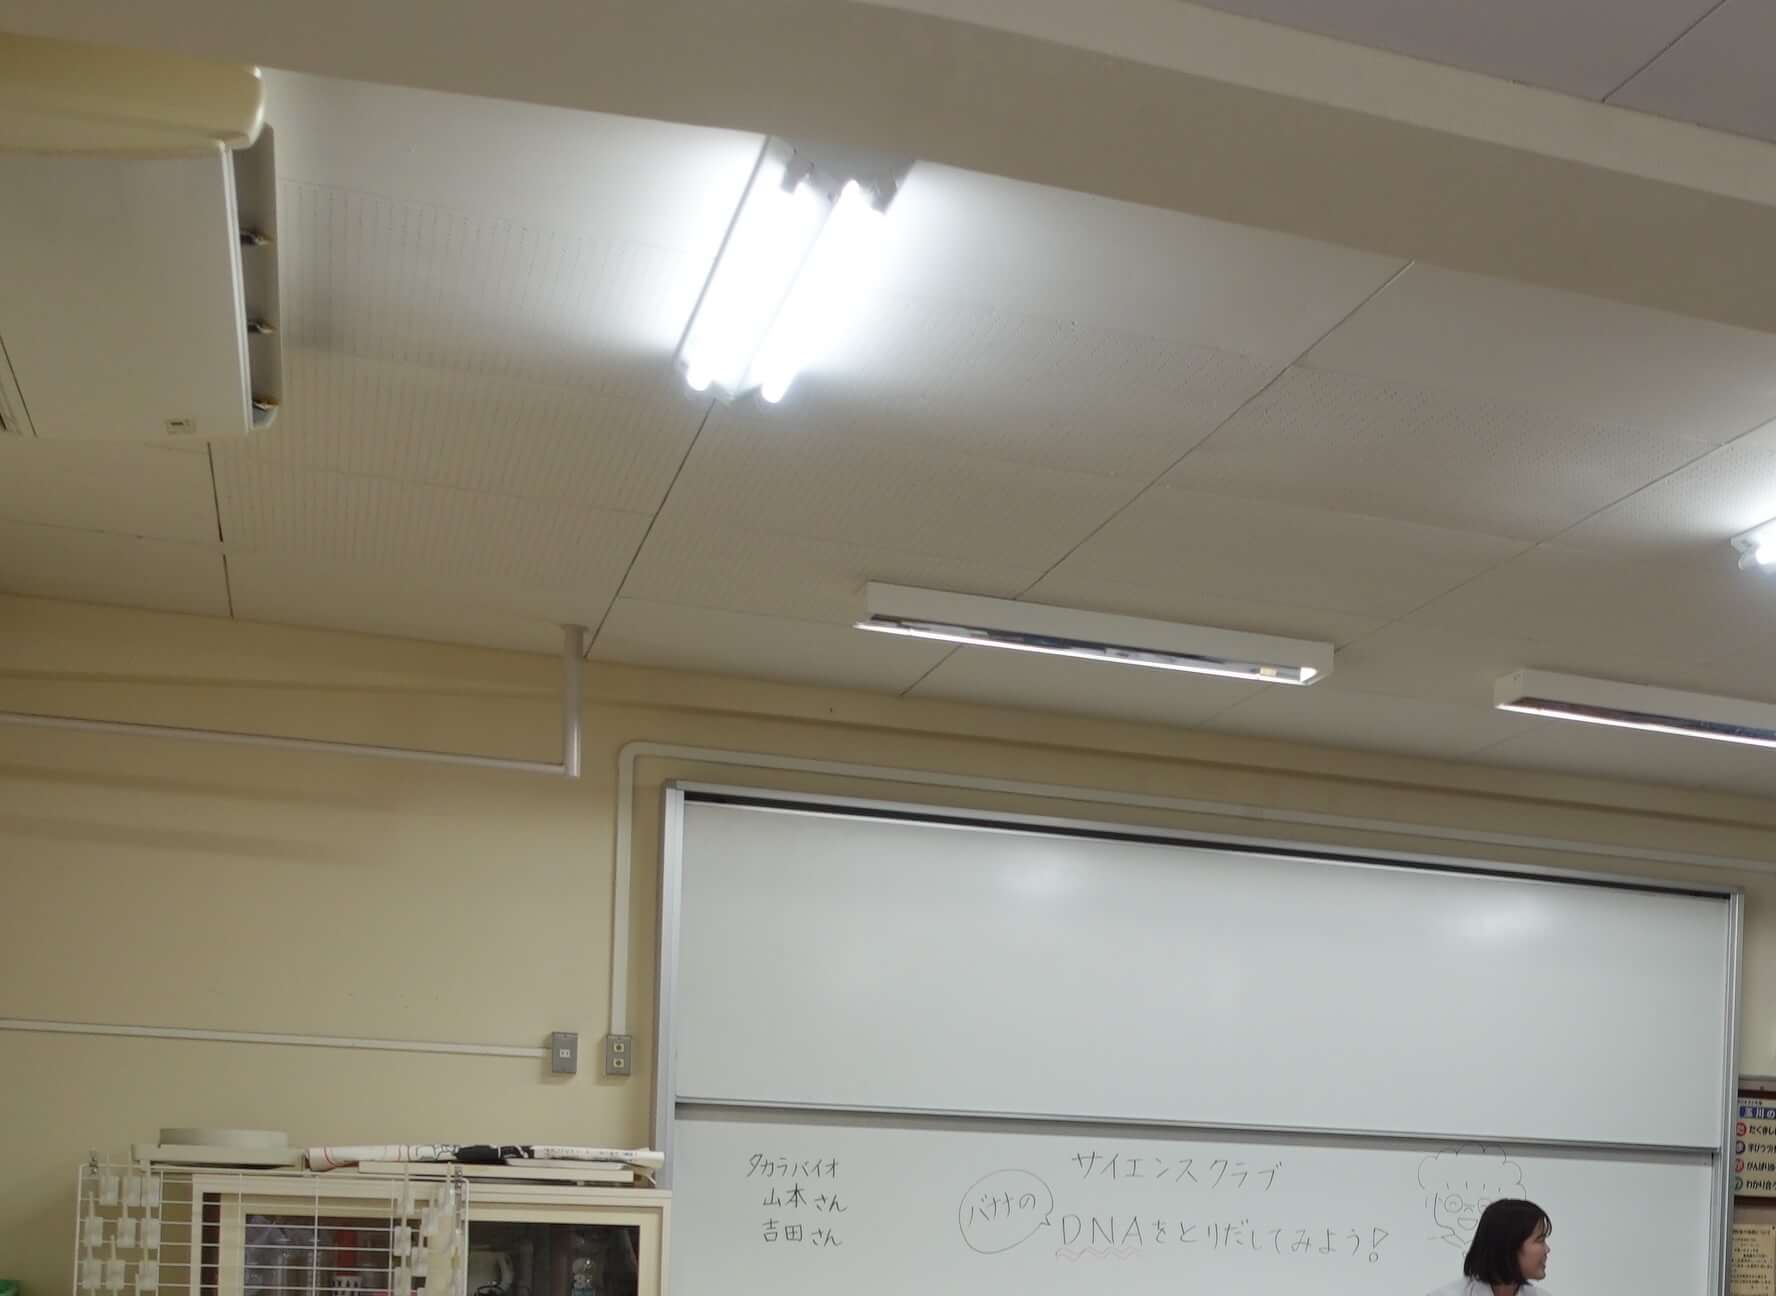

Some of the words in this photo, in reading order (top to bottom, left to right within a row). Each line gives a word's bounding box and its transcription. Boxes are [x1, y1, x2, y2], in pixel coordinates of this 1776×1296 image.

[747, 1153, 839, 1178] タカラバイオ
[1072, 1151, 1283, 1191] サイエンスクラブ
[763, 1182, 848, 1212] 山本さん
[969, 1191, 1036, 1225] バナナの
[762, 1218, 842, 1247] 吉田さん
